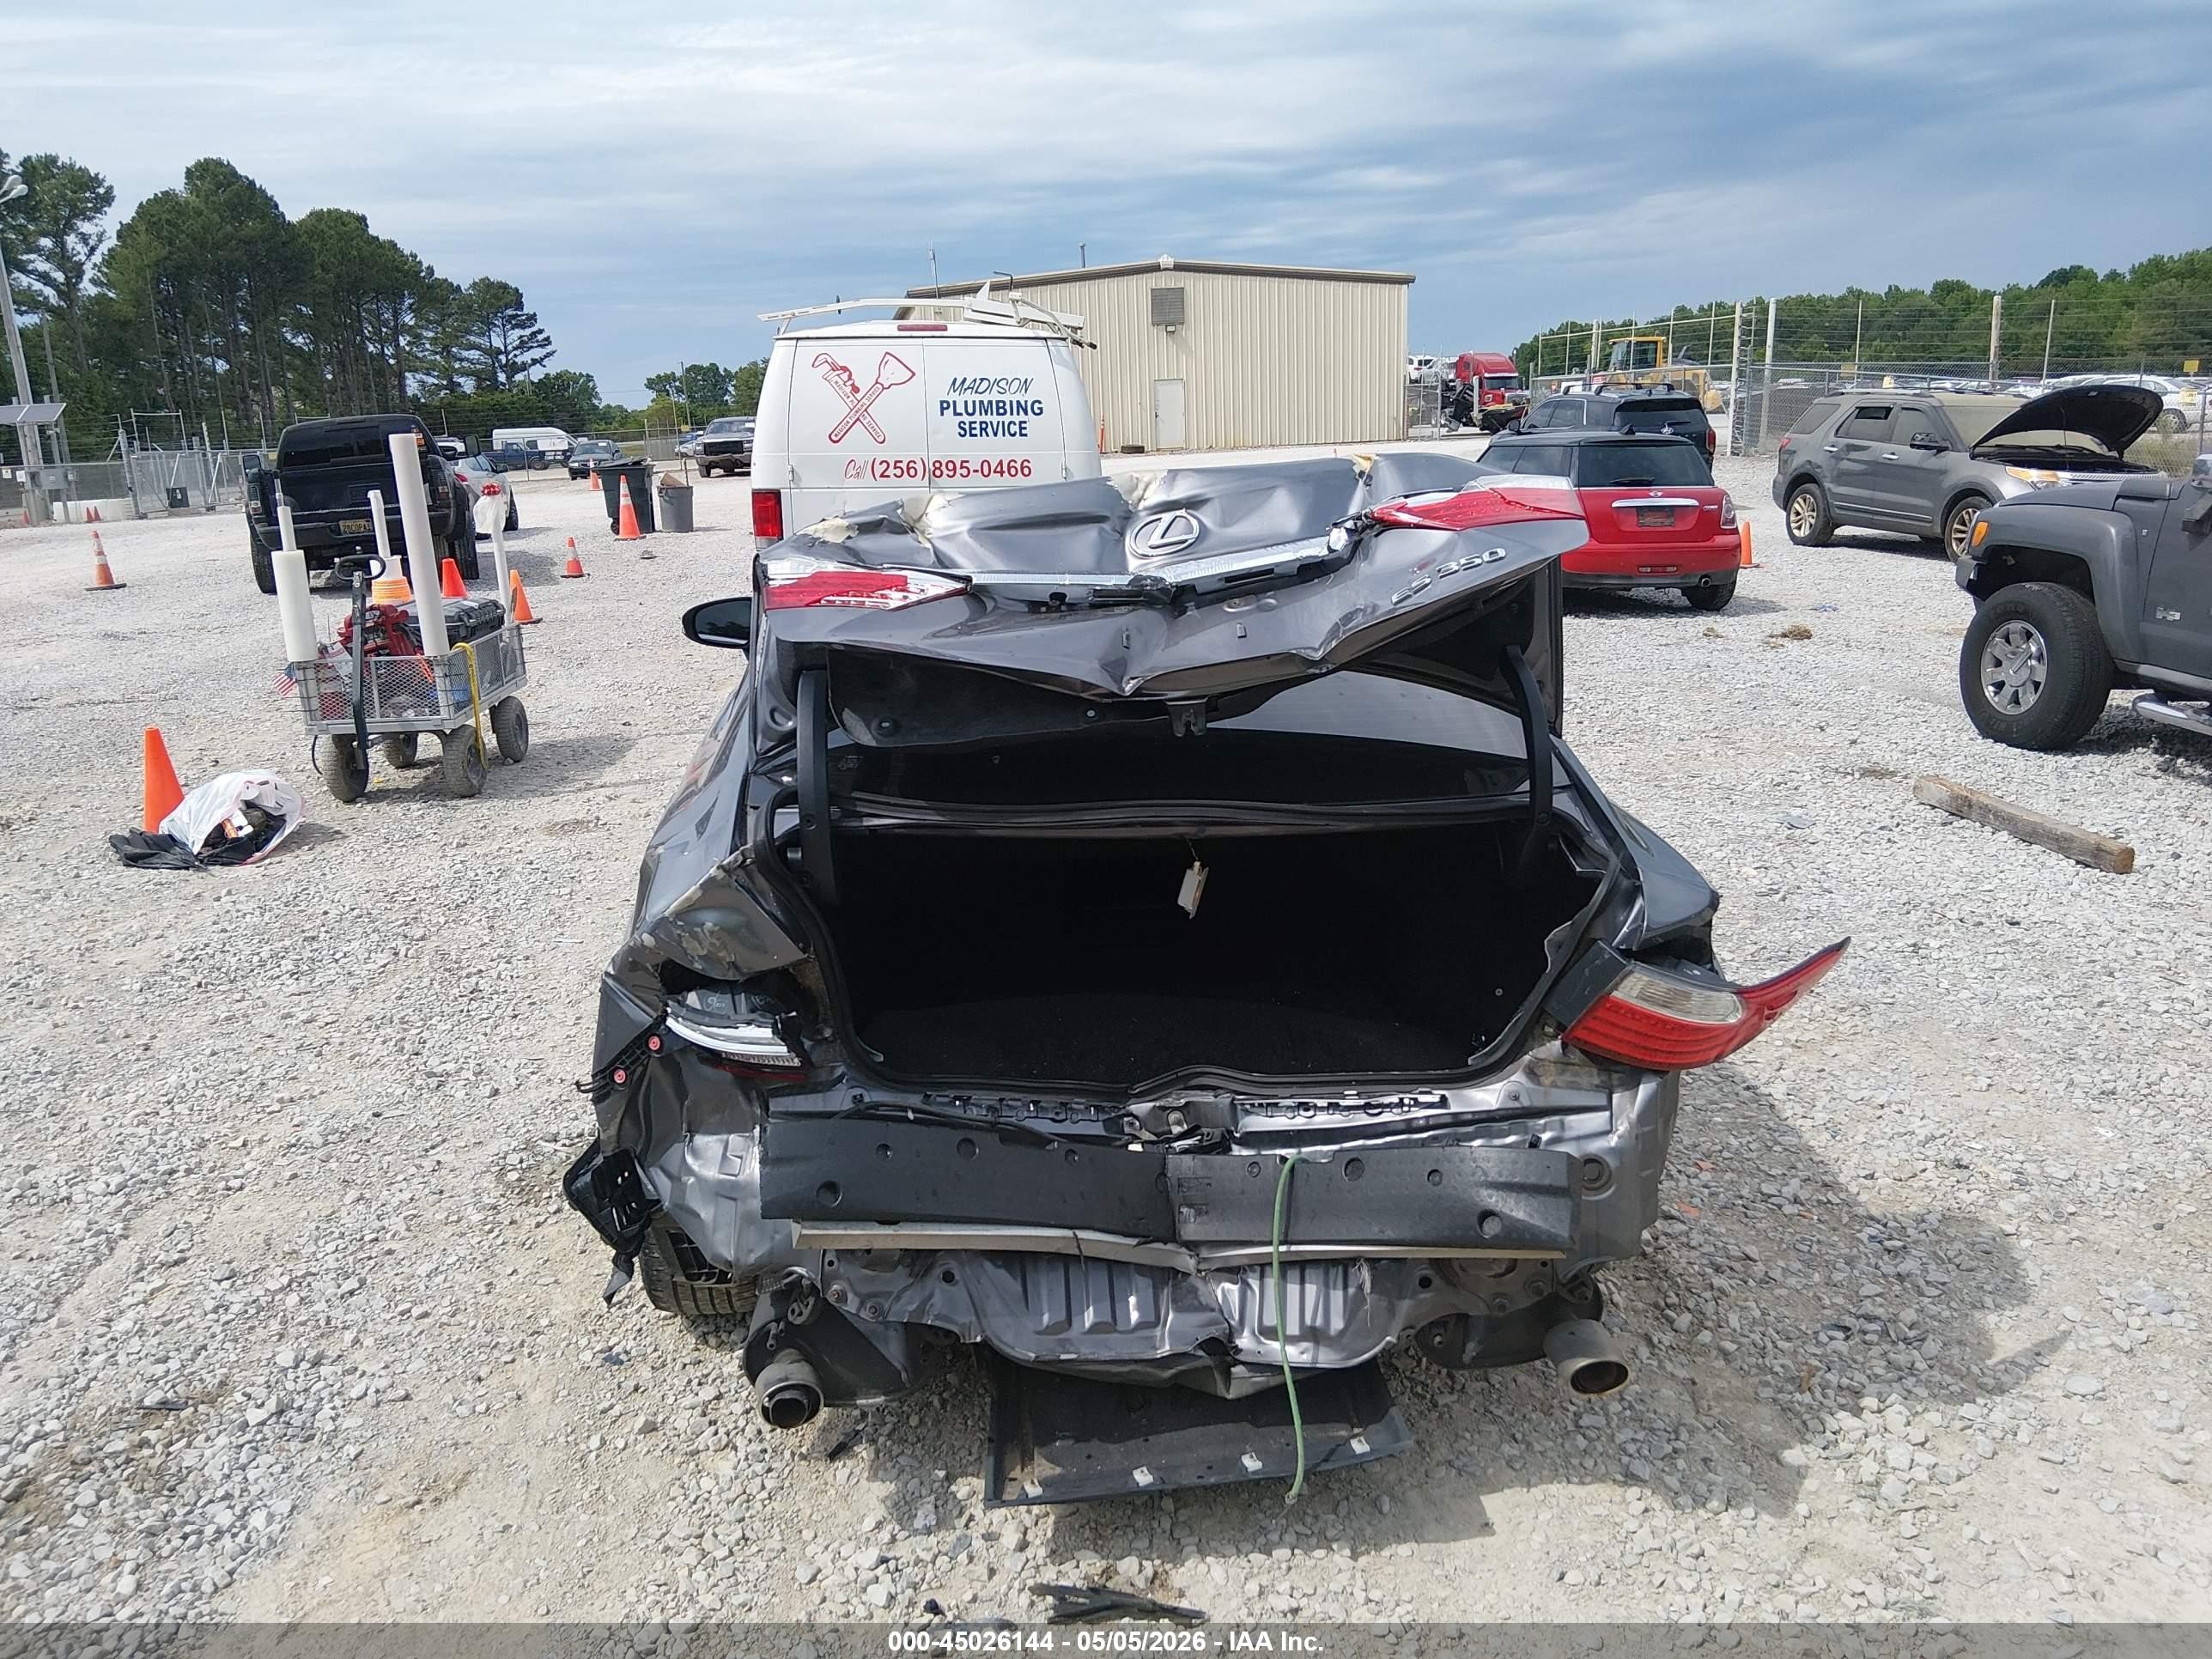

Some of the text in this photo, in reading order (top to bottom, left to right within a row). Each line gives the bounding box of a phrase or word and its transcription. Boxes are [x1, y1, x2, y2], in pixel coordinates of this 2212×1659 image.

[947, 376, 1034, 397] MADISON
[939, 399, 1044, 417] PLUMBING
[957, 421, 1029, 438] SERVICE
[845, 457, 1032, 481] Call (256) 895-0466
[1391, 547, 1506, 605] ES 350
[2156, 606, 2181, 621] H3
